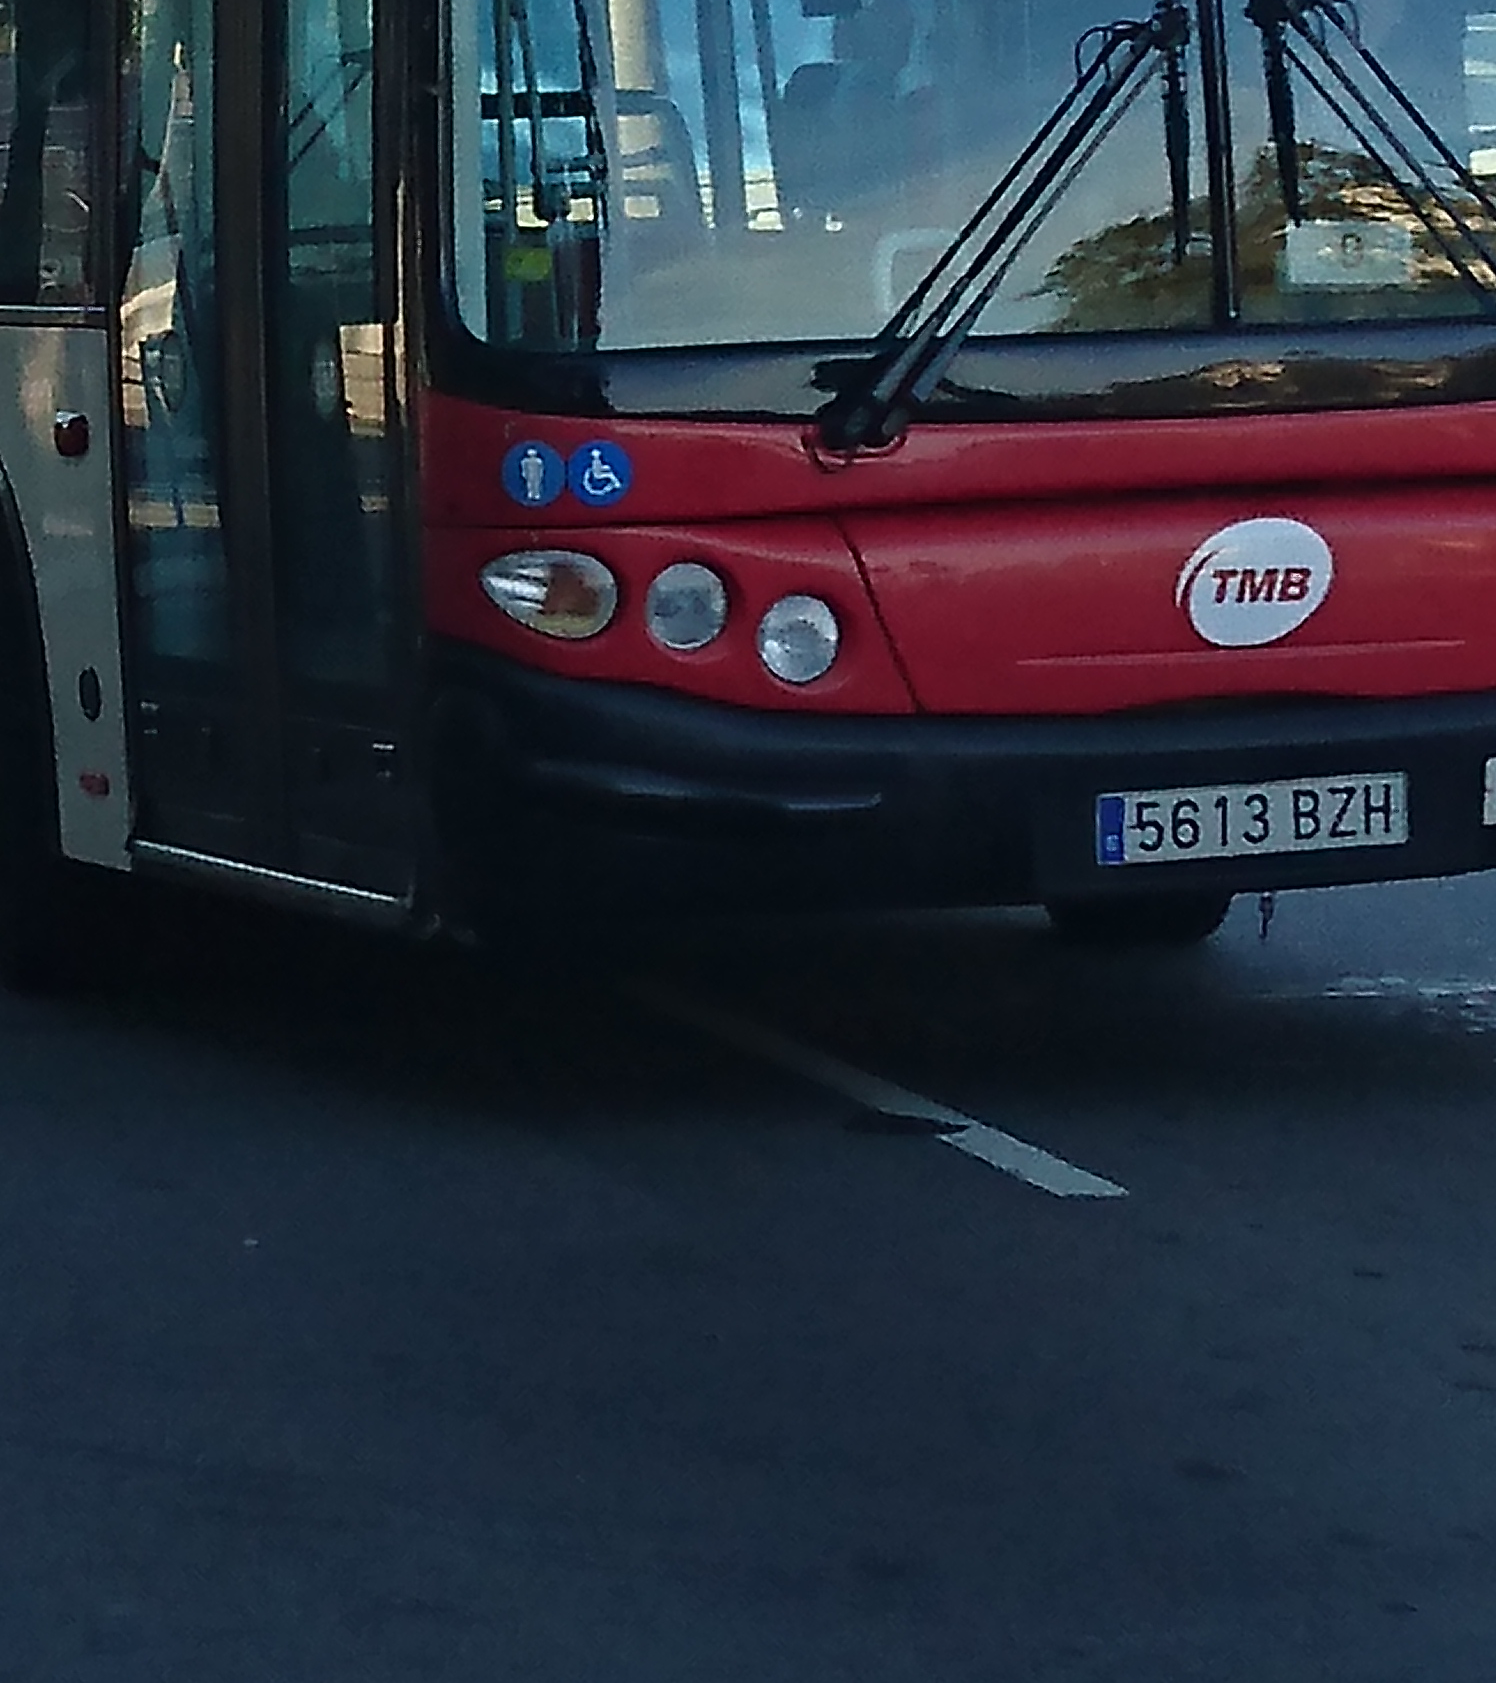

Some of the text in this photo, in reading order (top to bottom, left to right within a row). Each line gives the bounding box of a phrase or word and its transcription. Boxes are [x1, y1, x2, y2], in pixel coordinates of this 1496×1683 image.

[1211, 567, 1312, 604] TMB
[1134, 783, 1392, 852] 5613 BZH
